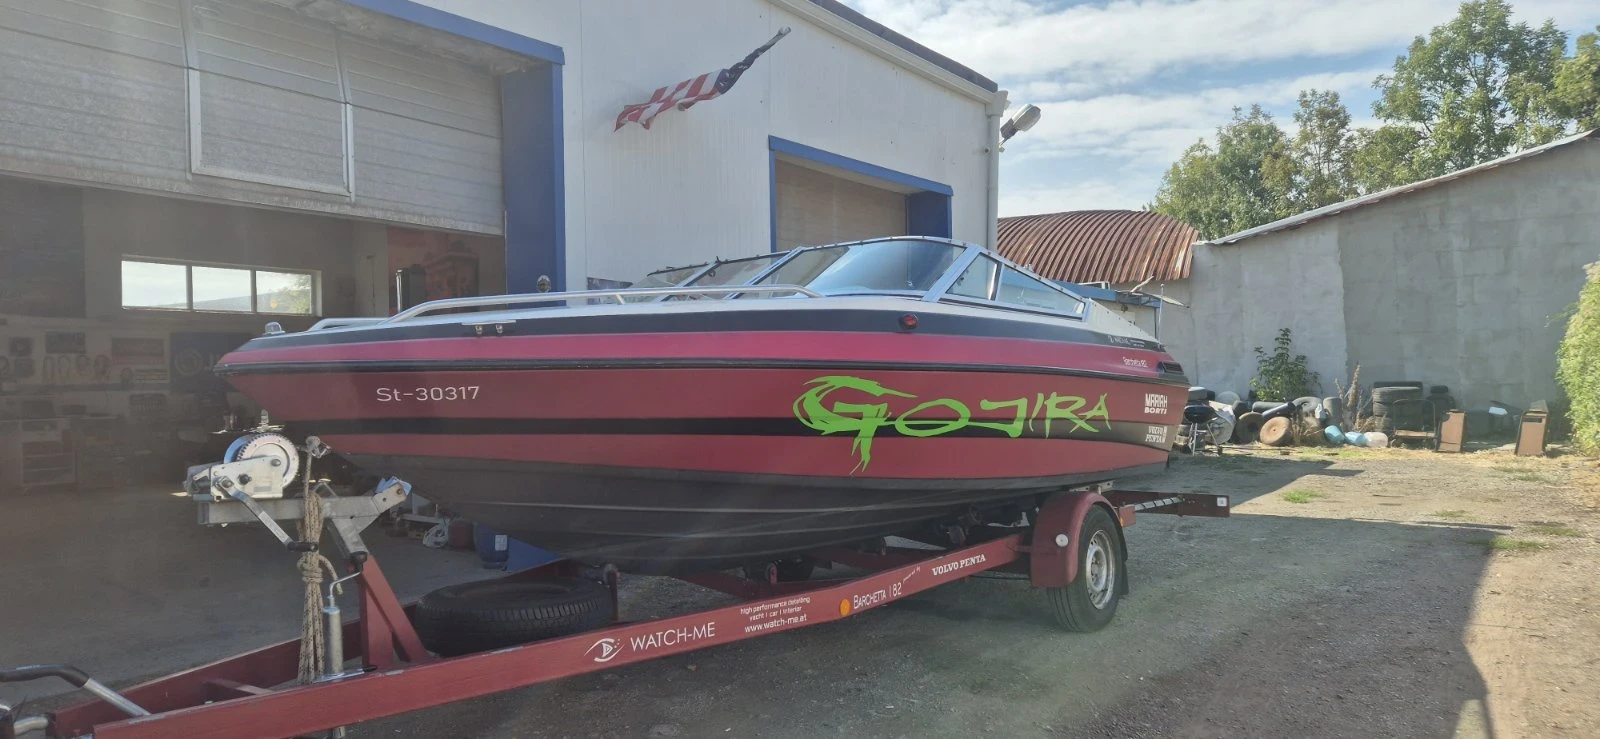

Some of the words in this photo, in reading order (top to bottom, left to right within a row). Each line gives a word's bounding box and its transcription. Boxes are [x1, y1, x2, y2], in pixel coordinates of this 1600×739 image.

[376, 385, 480, 402] St-30317
[932, 561, 958, 575] VOLVO
[959, 554, 986, 568] PENTA
[745, 613, 807, 632] www.watch-me.at
[630, 622, 715, 651] WATCH-ME
